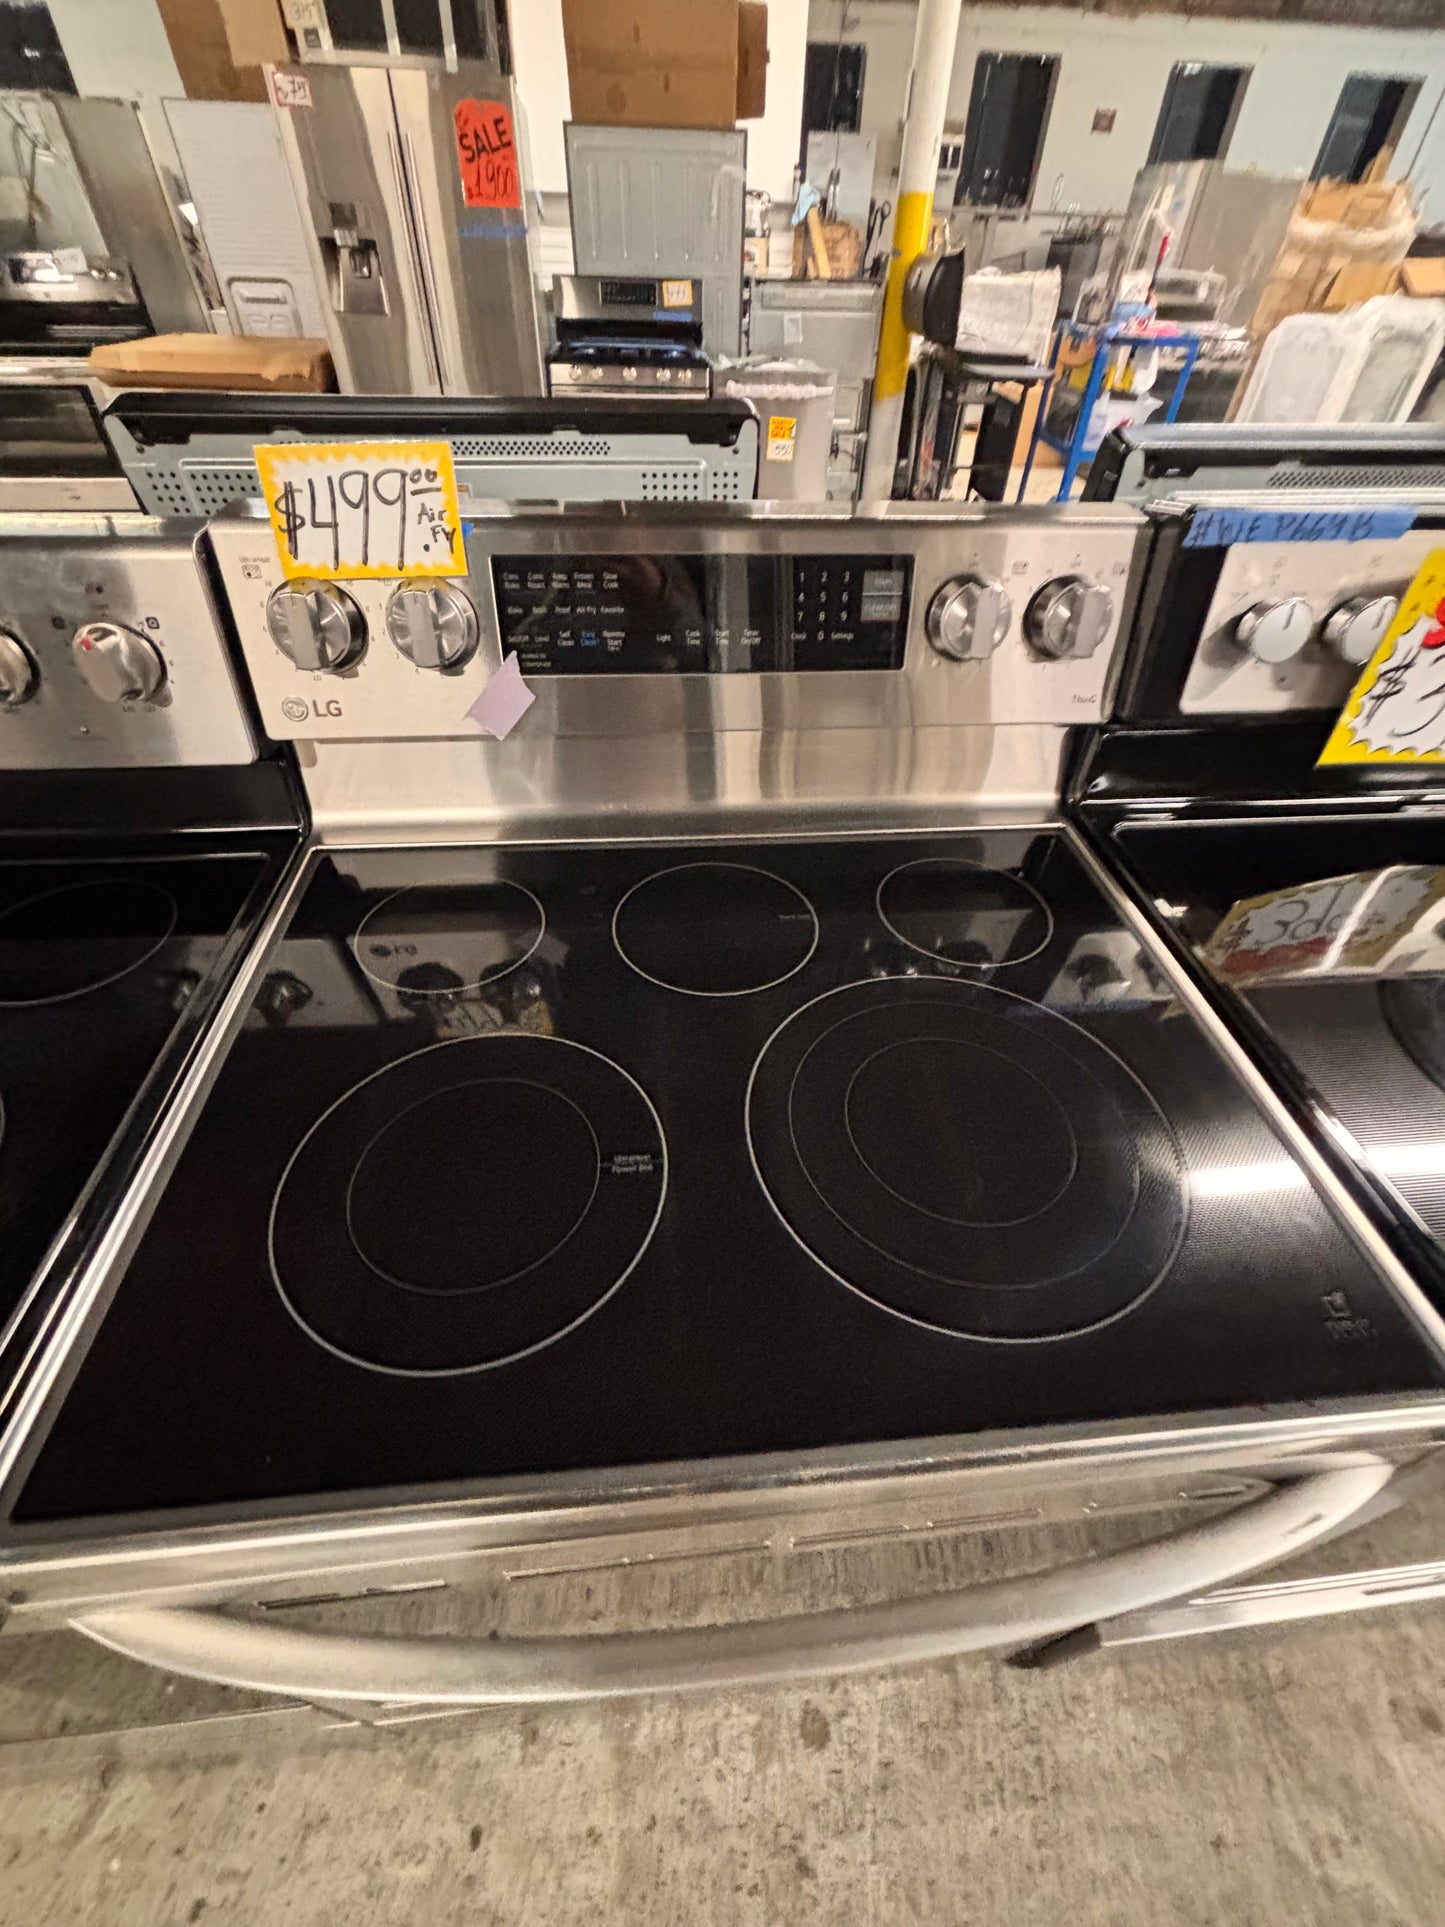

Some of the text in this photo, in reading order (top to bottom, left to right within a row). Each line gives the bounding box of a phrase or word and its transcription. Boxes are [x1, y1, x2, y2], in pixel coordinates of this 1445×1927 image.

[459, 115, 512, 163] SALE
[274, 468, 408, 571] $499
[417, 503, 446, 524] Air
[576, 606, 597, 616] Air Fry
[600, 605, 625, 614] Favorite
[656, 634, 672, 643] Light
[831, 632, 854, 641] Settings
[313, 699, 343, 717] LG
